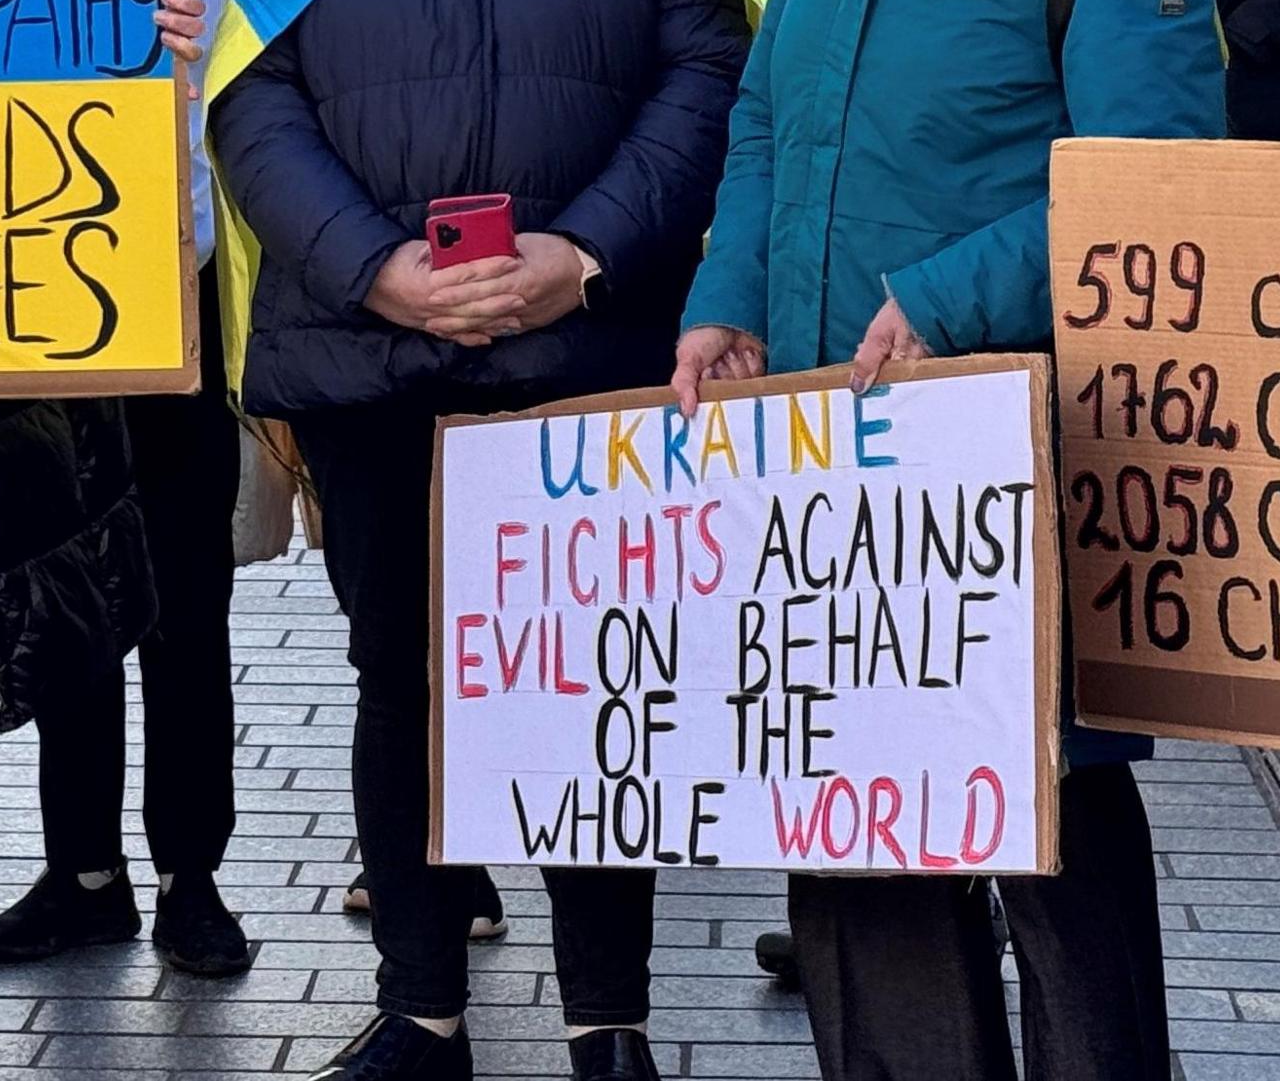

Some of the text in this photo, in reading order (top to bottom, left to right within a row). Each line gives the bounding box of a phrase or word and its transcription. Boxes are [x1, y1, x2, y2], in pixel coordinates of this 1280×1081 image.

[1062, 240, 1206, 333] 599
[540, 384, 899, 499] UKRAINE
[1076, 358, 1241, 451] 1762
[496, 482, 1034, 609] FIGHTS AGAINST
[1070, 464, 1240, 559] 2058
[457, 586, 999, 699] EVIL ON BEHALF
[1092, 559, 1191, 651] 16
[595, 691, 838, 781] OF THE
[512, 766, 1007, 869] WHOLE WORLD
